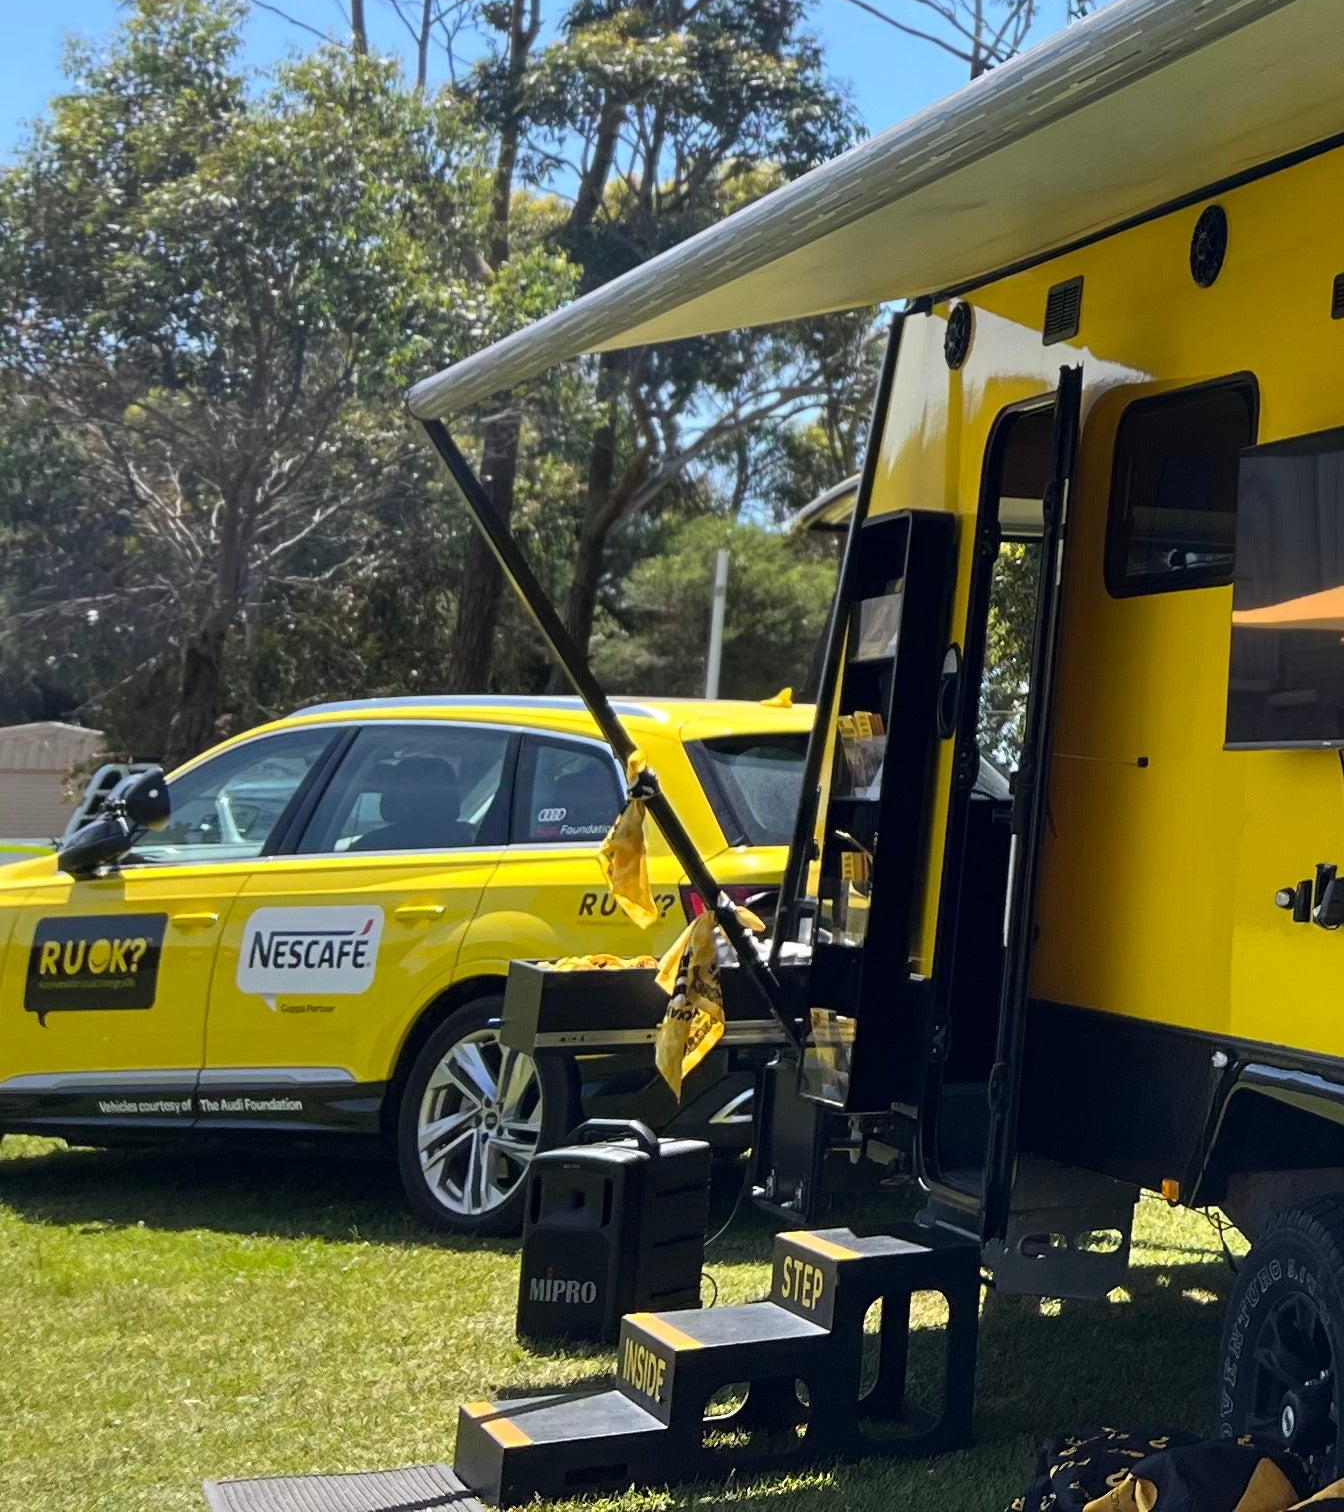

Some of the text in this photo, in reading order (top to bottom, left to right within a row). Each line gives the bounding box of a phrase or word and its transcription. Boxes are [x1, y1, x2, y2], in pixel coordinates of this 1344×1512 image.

[199, 1098, 220, 1112] The
[220, 1098, 244, 1112] Audi
[244, 1097, 303, 1111] Foundation
[781, 1256, 824, 1311] STEP
[622, 1337, 668, 1404] INSIDE
